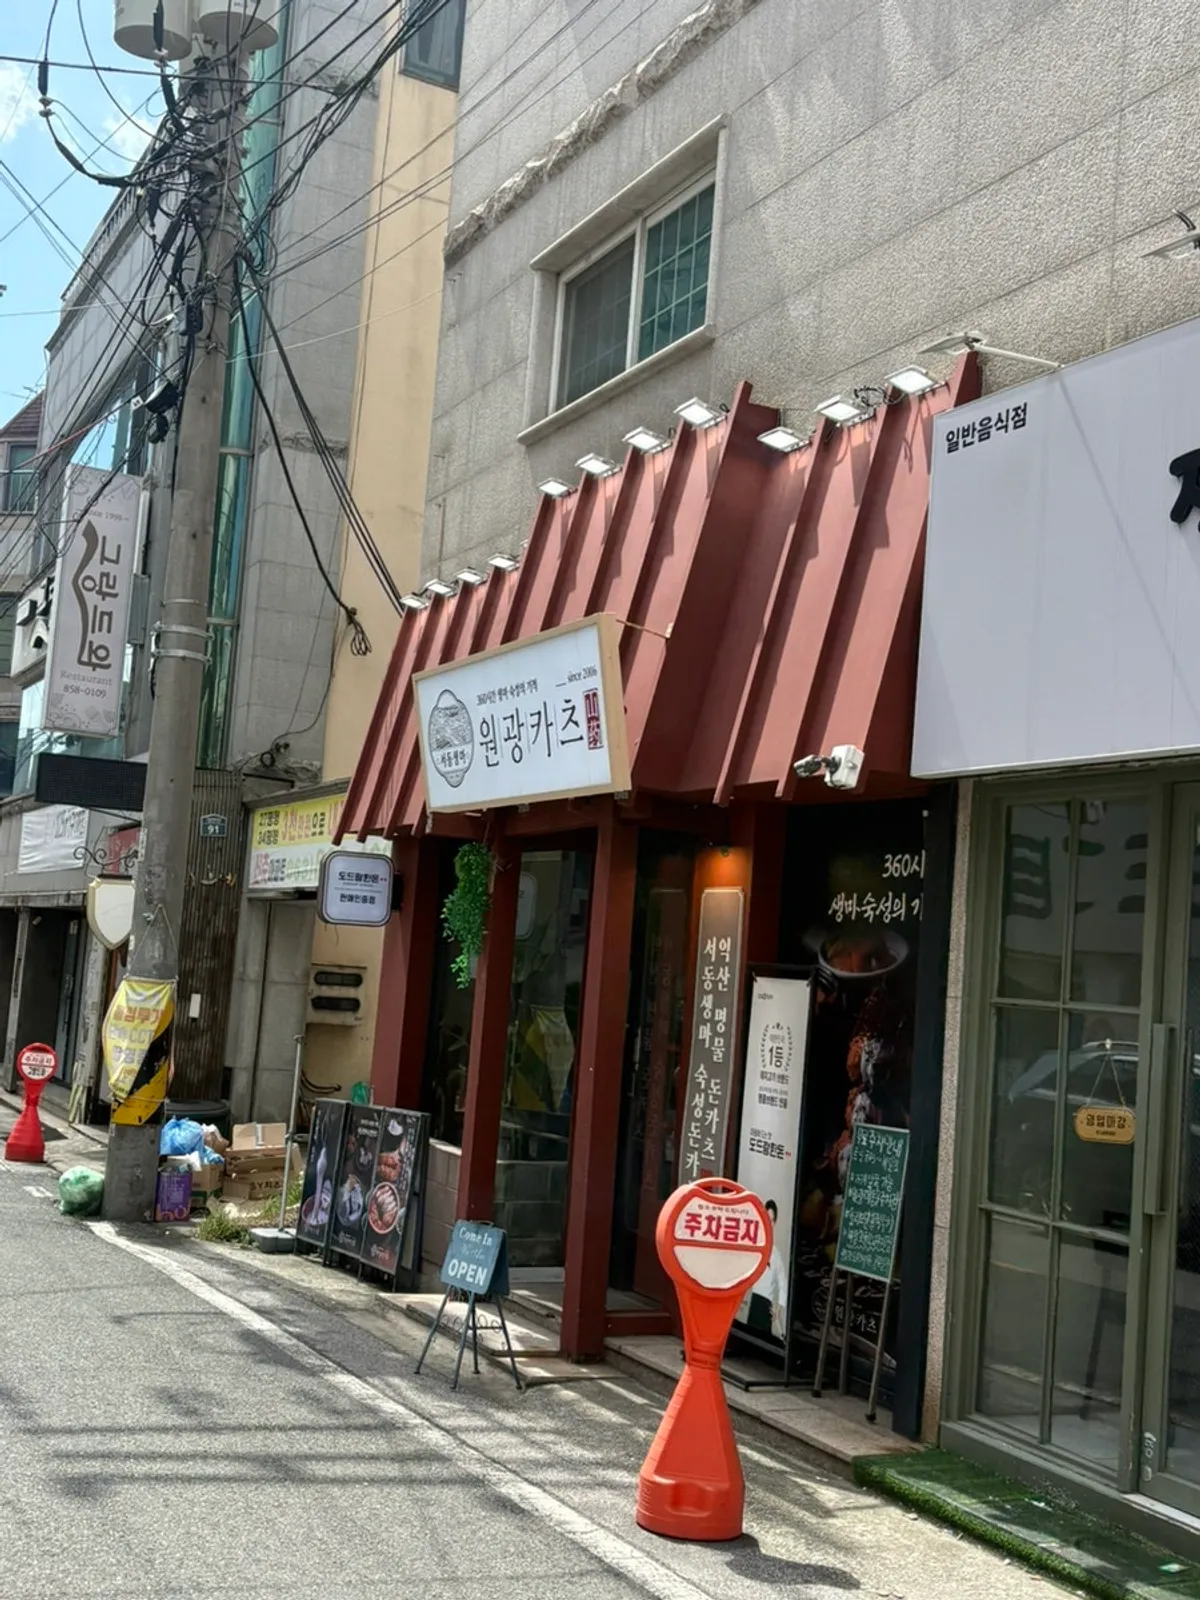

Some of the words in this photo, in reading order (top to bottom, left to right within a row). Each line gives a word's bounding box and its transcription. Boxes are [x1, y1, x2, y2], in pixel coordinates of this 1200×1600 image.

[945, 402, 1028, 454] 일반음식점
[80, 535, 122, 672] 그랑드와
[60, 670, 113, 686] Restaurant
[63, 684, 107, 698] 858-0109
[479, 698, 585, 767] 원광카츠
[207, 824, 220, 835] 91
[881, 849, 926, 879] 360시
[716, 936, 732, 992] 익산
[698, 936, 717, 1050] 서동생마
[711, 1006, 728, 1063] 명물
[685, 1063, 708, 1184] 숙성돈카
[701, 1078, 723, 1161] 돈카츠
[459, 1226, 482, 1244] Come
[482, 1232, 493, 1247] In
[684, 1212, 760, 1245] 주차금지
[448, 1258, 488, 1287] OPEN
